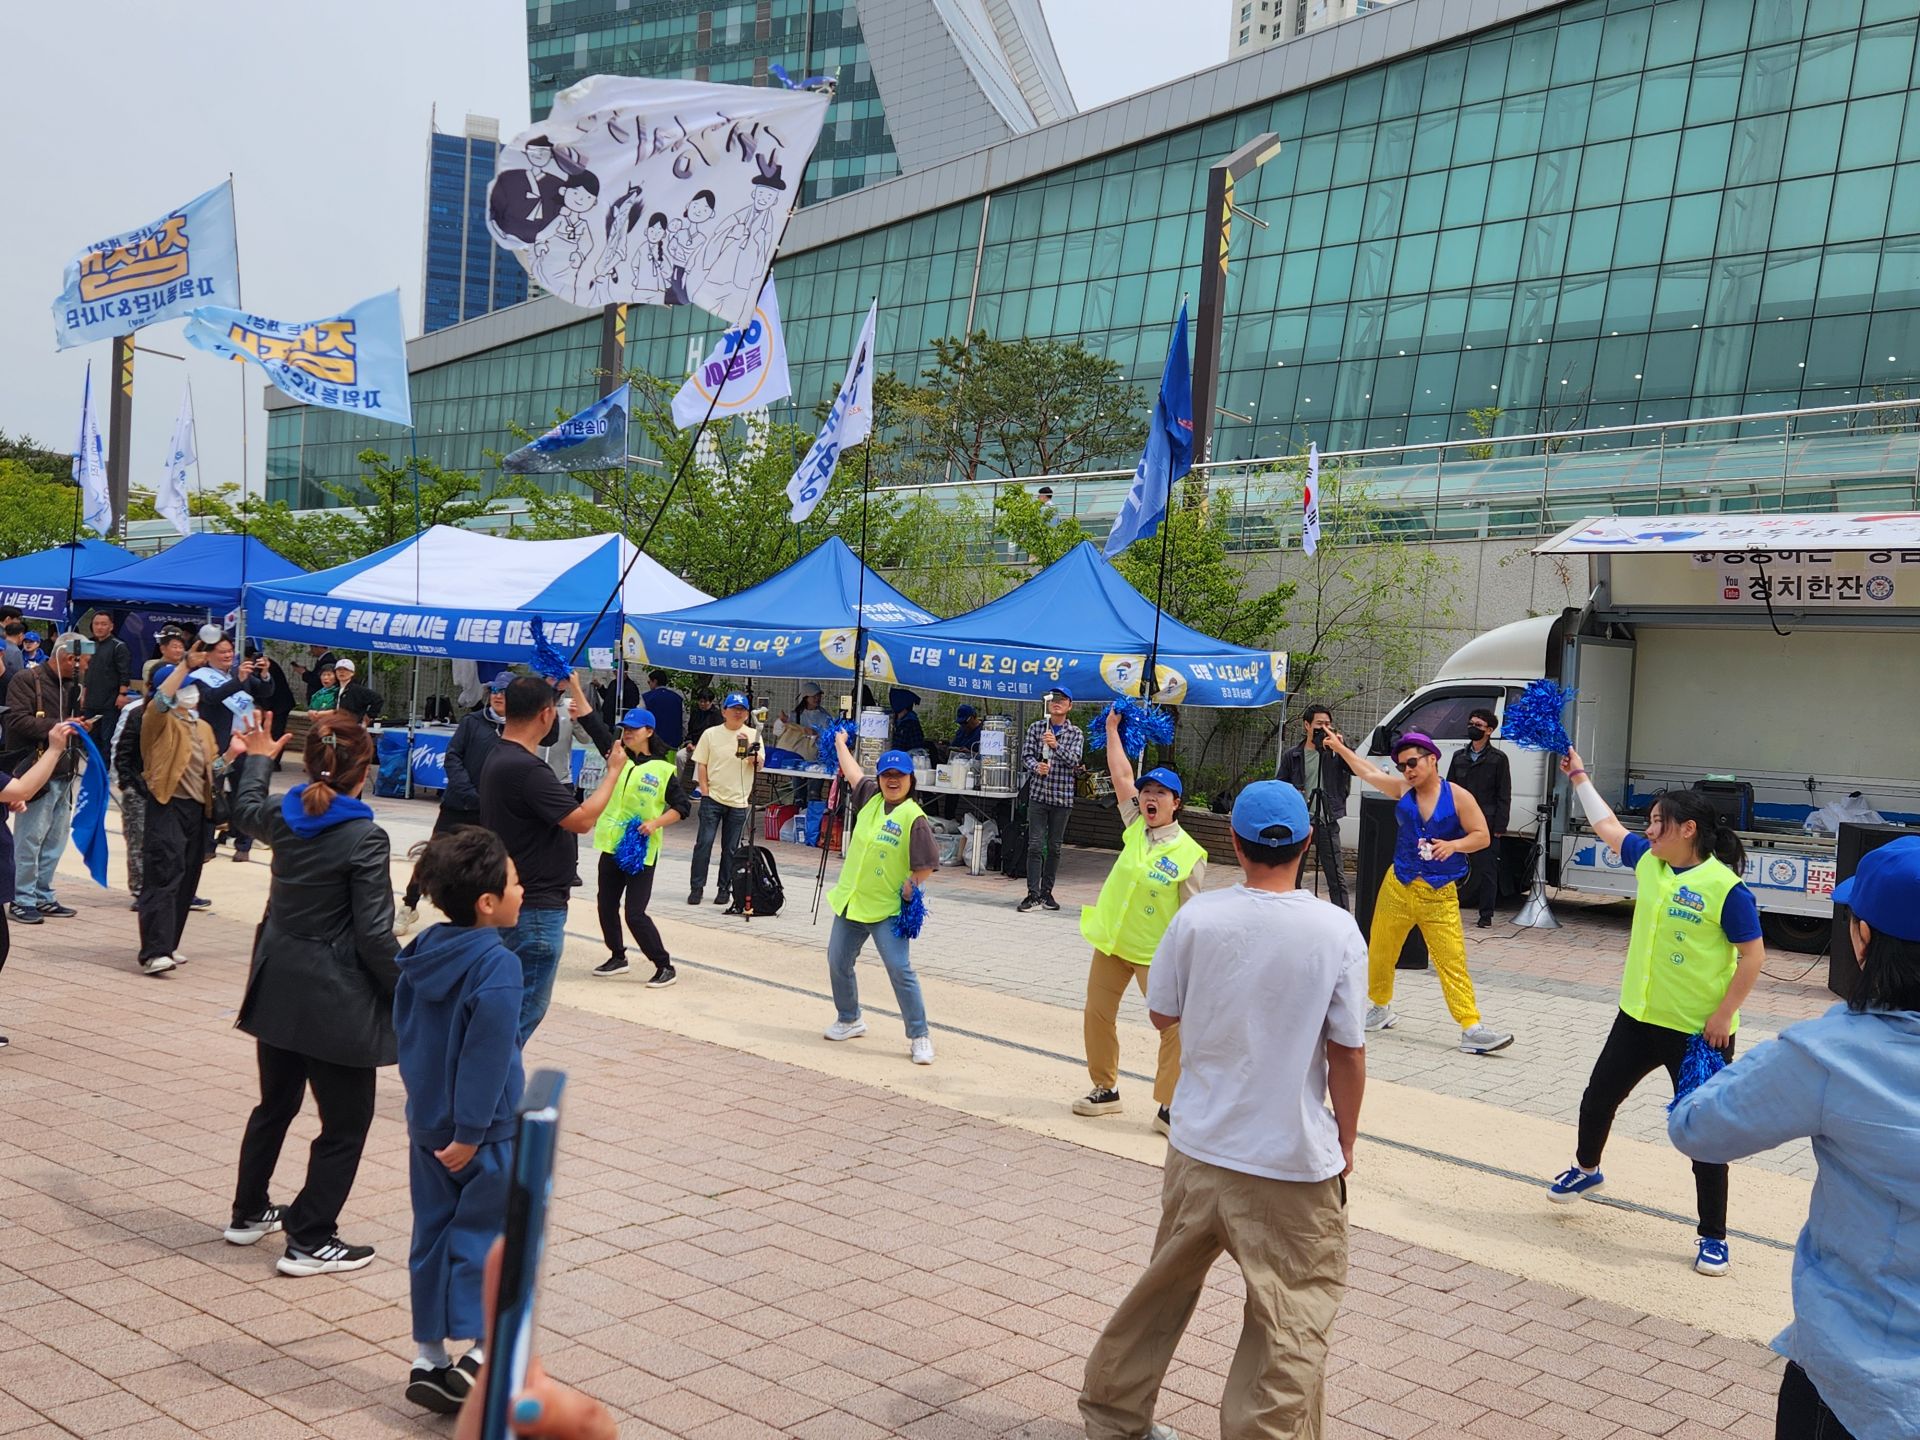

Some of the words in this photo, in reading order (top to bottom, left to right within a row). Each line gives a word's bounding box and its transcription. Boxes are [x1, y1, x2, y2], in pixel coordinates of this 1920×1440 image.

[1725, 576, 1738, 587] You
[1748, 575, 1864, 601] 정치한잔
[4, 592, 54, 611] 네트워크
[1725, 590, 1739, 598] Tube
[345, 609, 391, 635] 국민과
[454, 617, 503, 644] 새로운
[657, 628, 686, 647] 더명
[689, 654, 706, 667] 명과
[709, 656, 727, 669] 함께
[730, 658, 761, 670] 승리를!
[909, 646, 943, 667] 더명
[947, 675, 967, 688] 명과
[972, 678, 992, 691] 함께
[996, 681, 1033, 694] 승리를!
